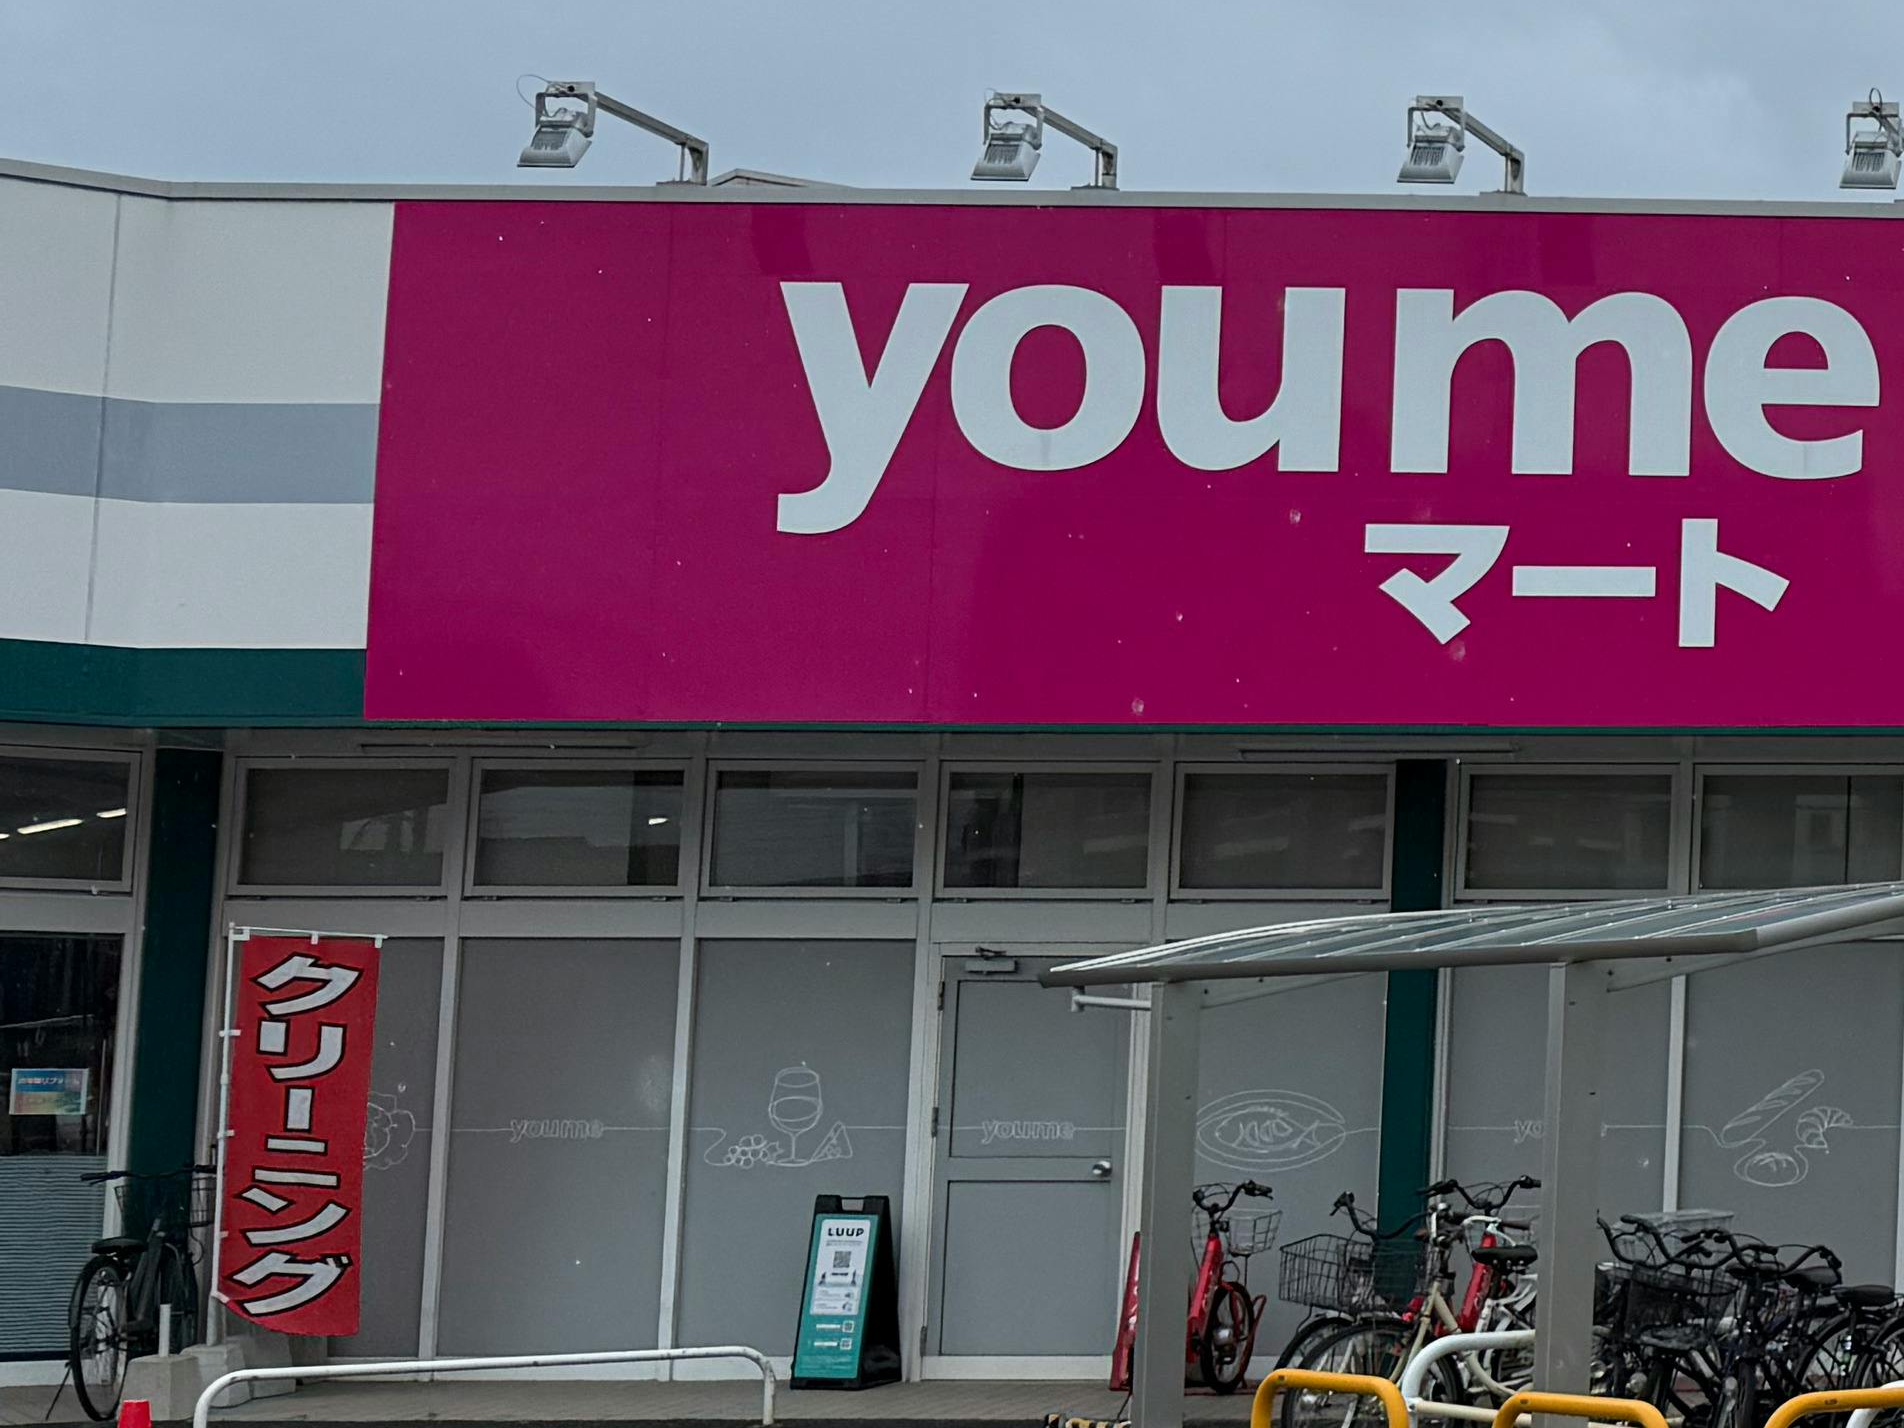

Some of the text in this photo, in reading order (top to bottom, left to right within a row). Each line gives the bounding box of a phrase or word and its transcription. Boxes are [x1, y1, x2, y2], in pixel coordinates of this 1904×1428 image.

[777, 280, 1881, 535] youme
[1364, 517, 1791, 649] マート
[229, 952, 364, 1317] クリーニング
[828, 1227, 864, 1237] LUUP
